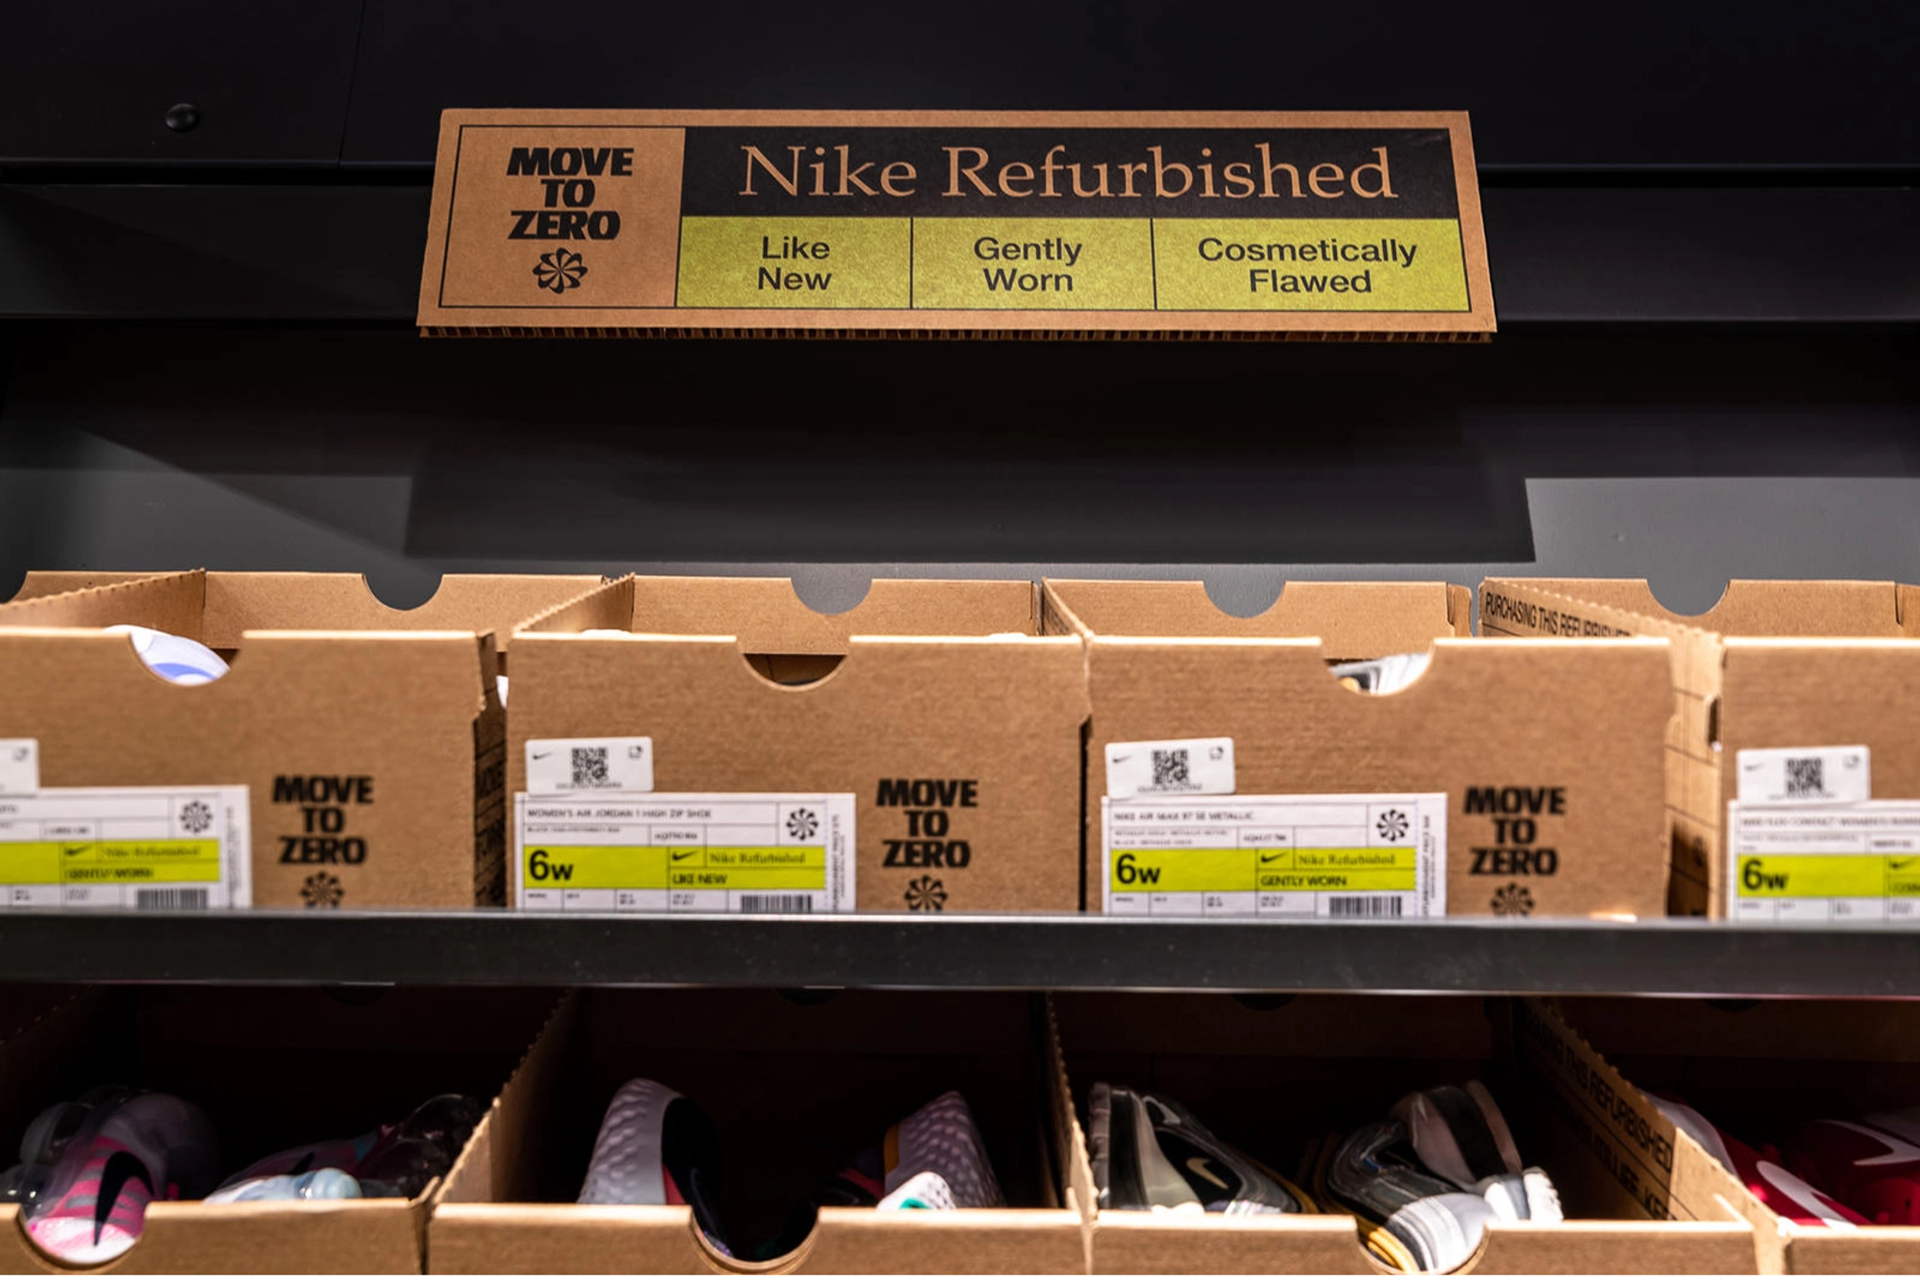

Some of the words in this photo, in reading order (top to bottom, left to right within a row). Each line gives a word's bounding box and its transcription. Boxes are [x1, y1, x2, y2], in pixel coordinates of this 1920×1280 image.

[507, 147, 634, 176] MOVE
[739, 145, 917, 198] Nike
[941, 143, 1399, 199] Refurbished
[540, 179, 596, 208] TO
[507, 210, 621, 240] ZERO
[762, 235, 831, 260] Like
[973, 237, 1083, 266] Gently
[1198, 237, 1417, 267] Cosmetically
[758, 267, 832, 291] New
[983, 268, 1074, 293] Worn
[1250, 269, 1372, 294] Flawed
[1485, 591, 1537, 629] PURCHASING
[1538, 606, 1559, 636] THIS
[272, 774, 375, 804] MOVE
[876, 778, 979, 807] MOVE
[1464, 785, 1566, 815] MOVE
[300, 806, 345, 834] TO
[903, 809, 949, 837] TO
[1491, 817, 1537, 846] TO
[277, 835, 368, 866] ZERO
[710, 853, 736, 863] Nike
[740, 853, 806, 864] Refurbished
[882, 839, 972, 868] ZERO
[1298, 854, 1325, 864] Nike
[1468, 847, 1560, 877] ZERO
[672, 873, 695, 884] LIKE
[698, 873, 728, 884] NEW
[1260, 875, 1304, 887] GENTLY
[1307, 875, 1347, 887] WORN
